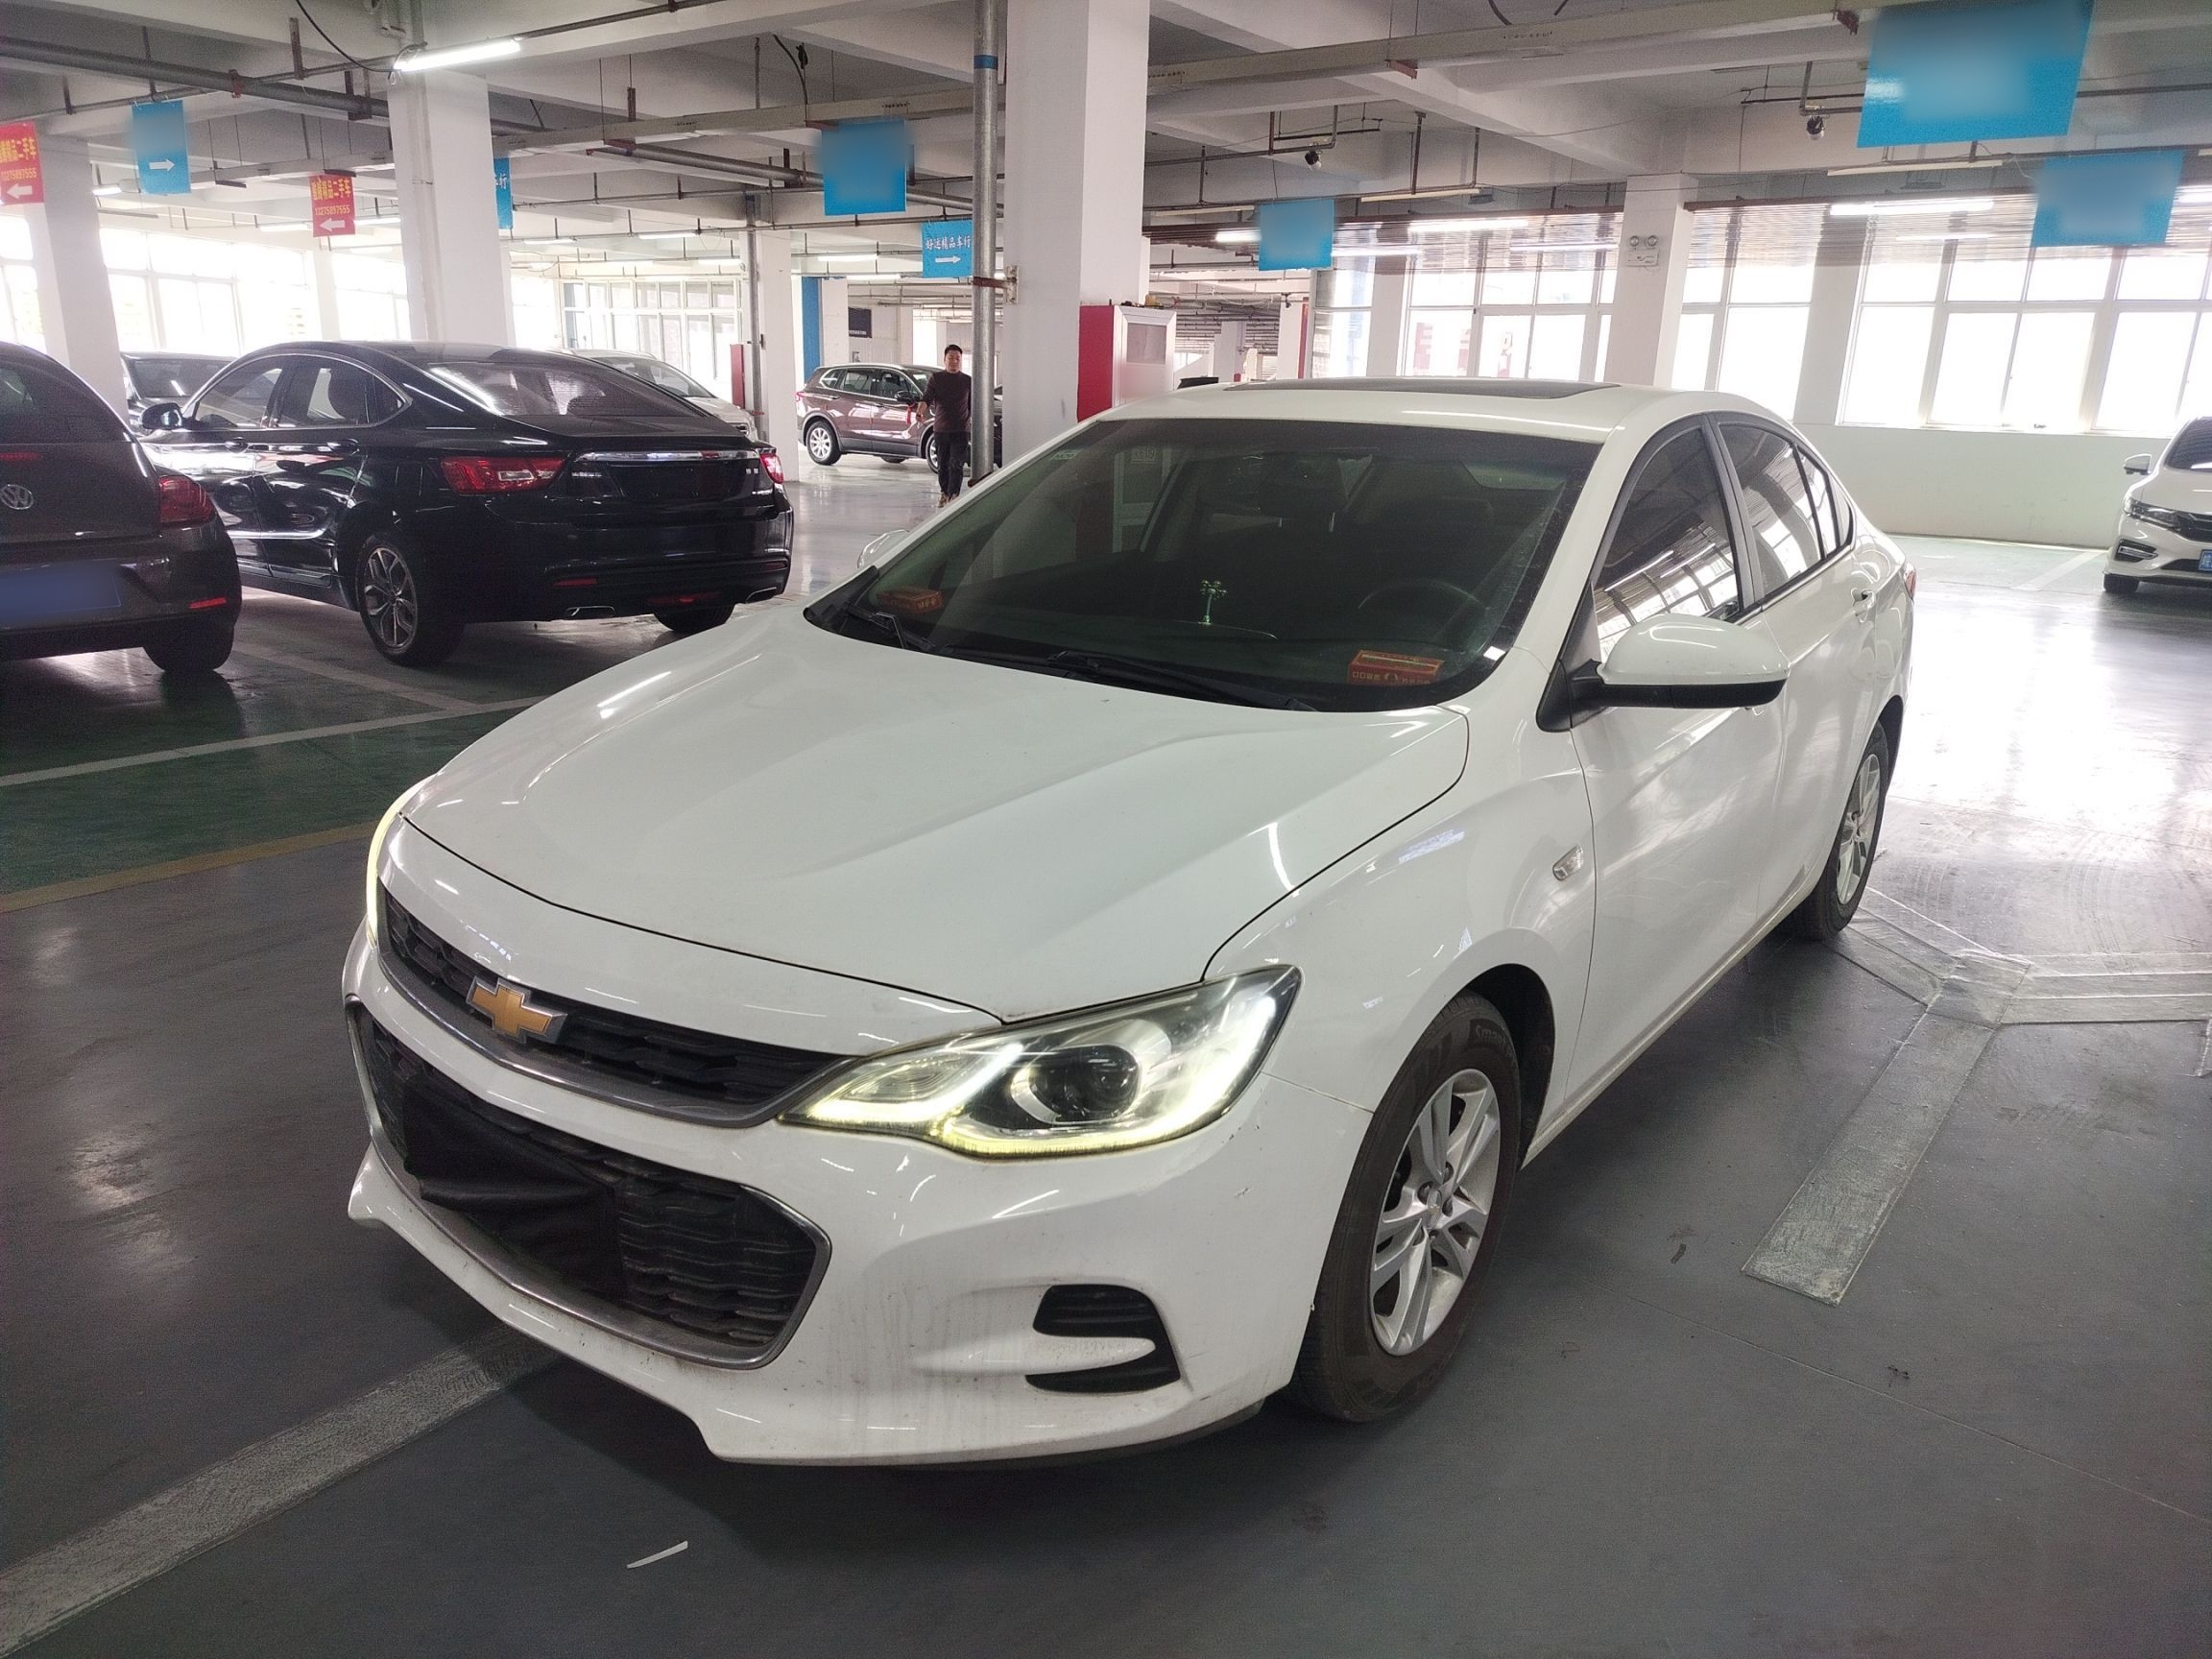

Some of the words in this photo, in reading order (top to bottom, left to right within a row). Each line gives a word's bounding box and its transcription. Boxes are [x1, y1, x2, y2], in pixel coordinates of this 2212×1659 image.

[926, 234, 971, 251] 好运精品车行
